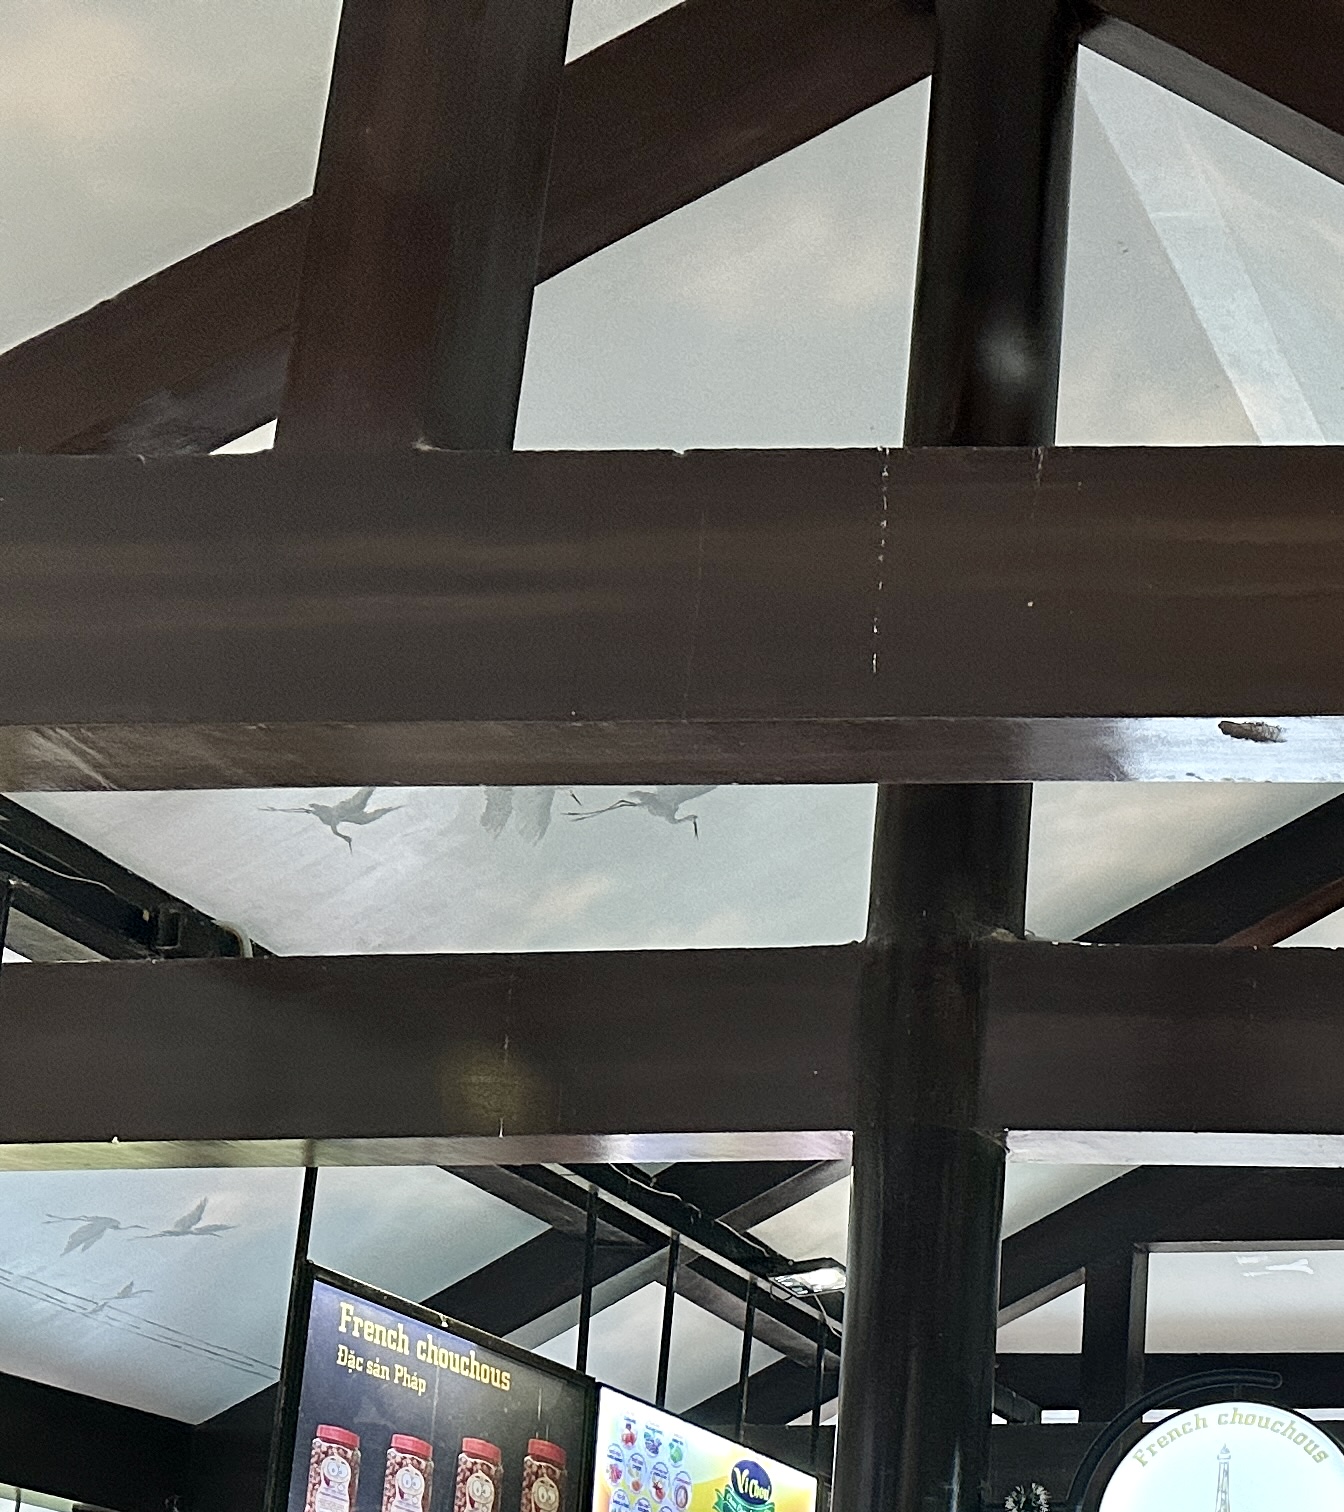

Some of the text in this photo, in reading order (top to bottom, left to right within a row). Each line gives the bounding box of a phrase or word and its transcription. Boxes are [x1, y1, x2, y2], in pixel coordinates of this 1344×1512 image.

[336, 1344, 427, 1396] Đặc sản Pháp
[338, 1301, 512, 1392] French chouchous
[1131, 1407, 1329, 1467] French chouchous
